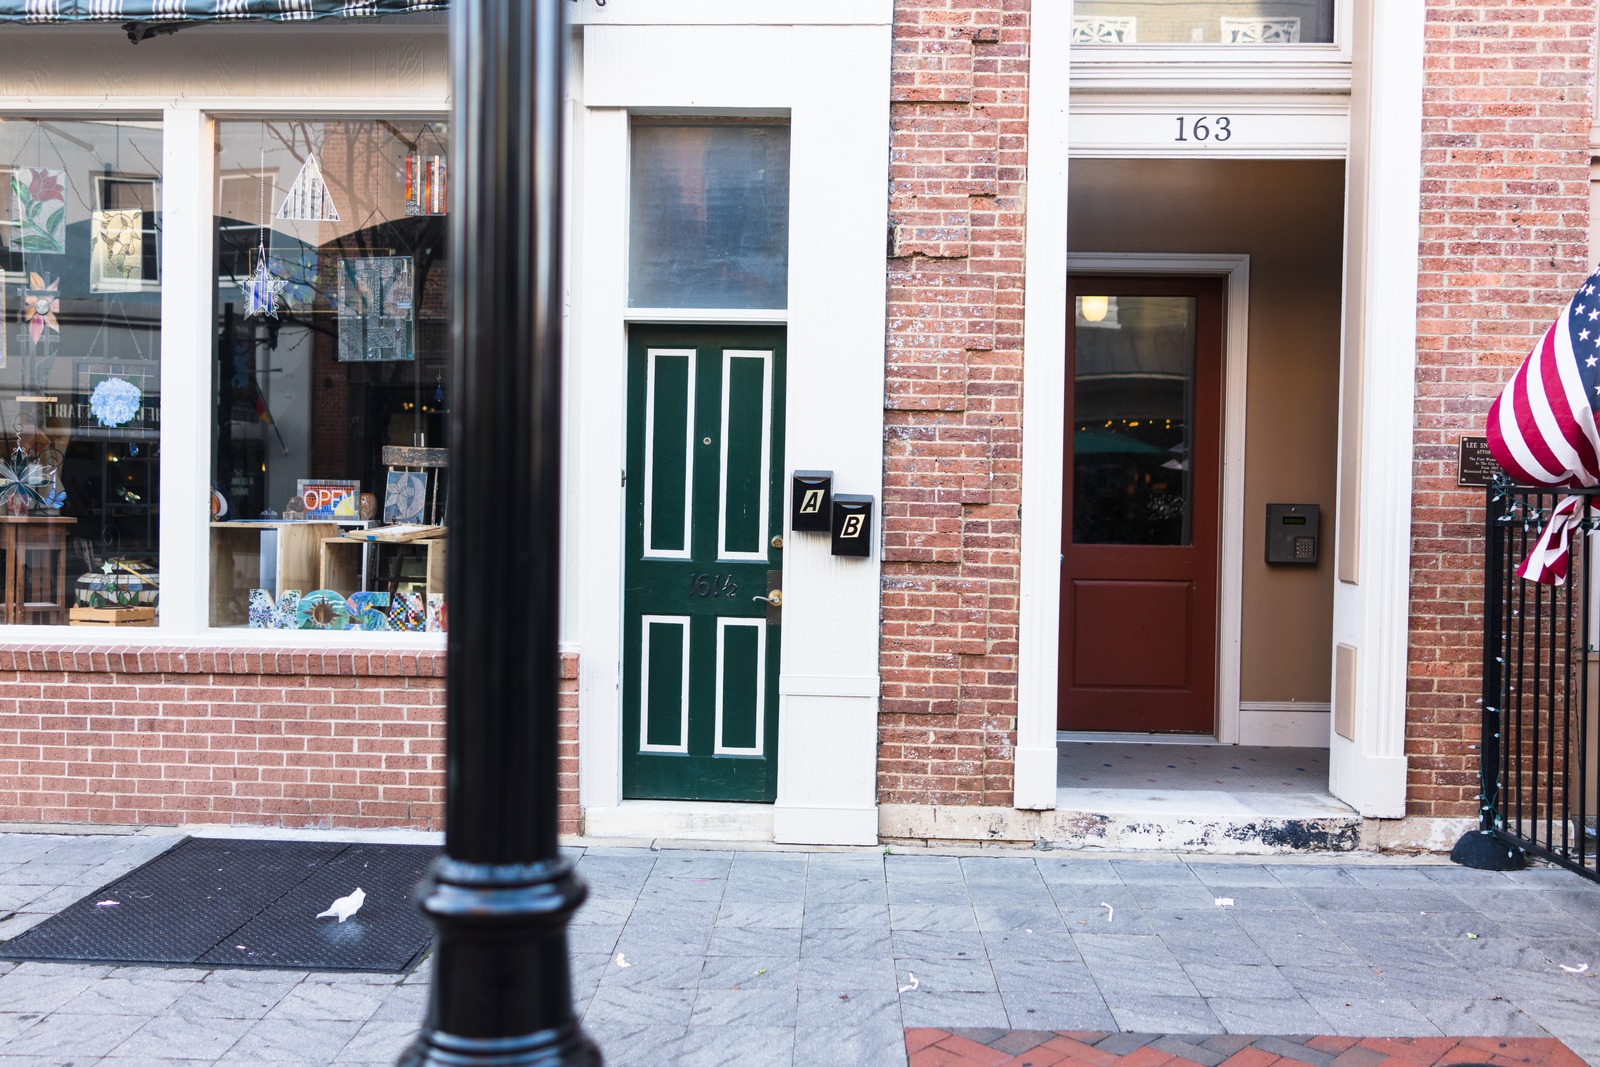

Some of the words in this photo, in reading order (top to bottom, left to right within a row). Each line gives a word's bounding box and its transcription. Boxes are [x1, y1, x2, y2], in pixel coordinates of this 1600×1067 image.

[1174, 116, 1232, 142] 163
[303, 489, 354, 511] OPEN
[801, 491, 819, 512] A
[842, 516, 860, 537] B
